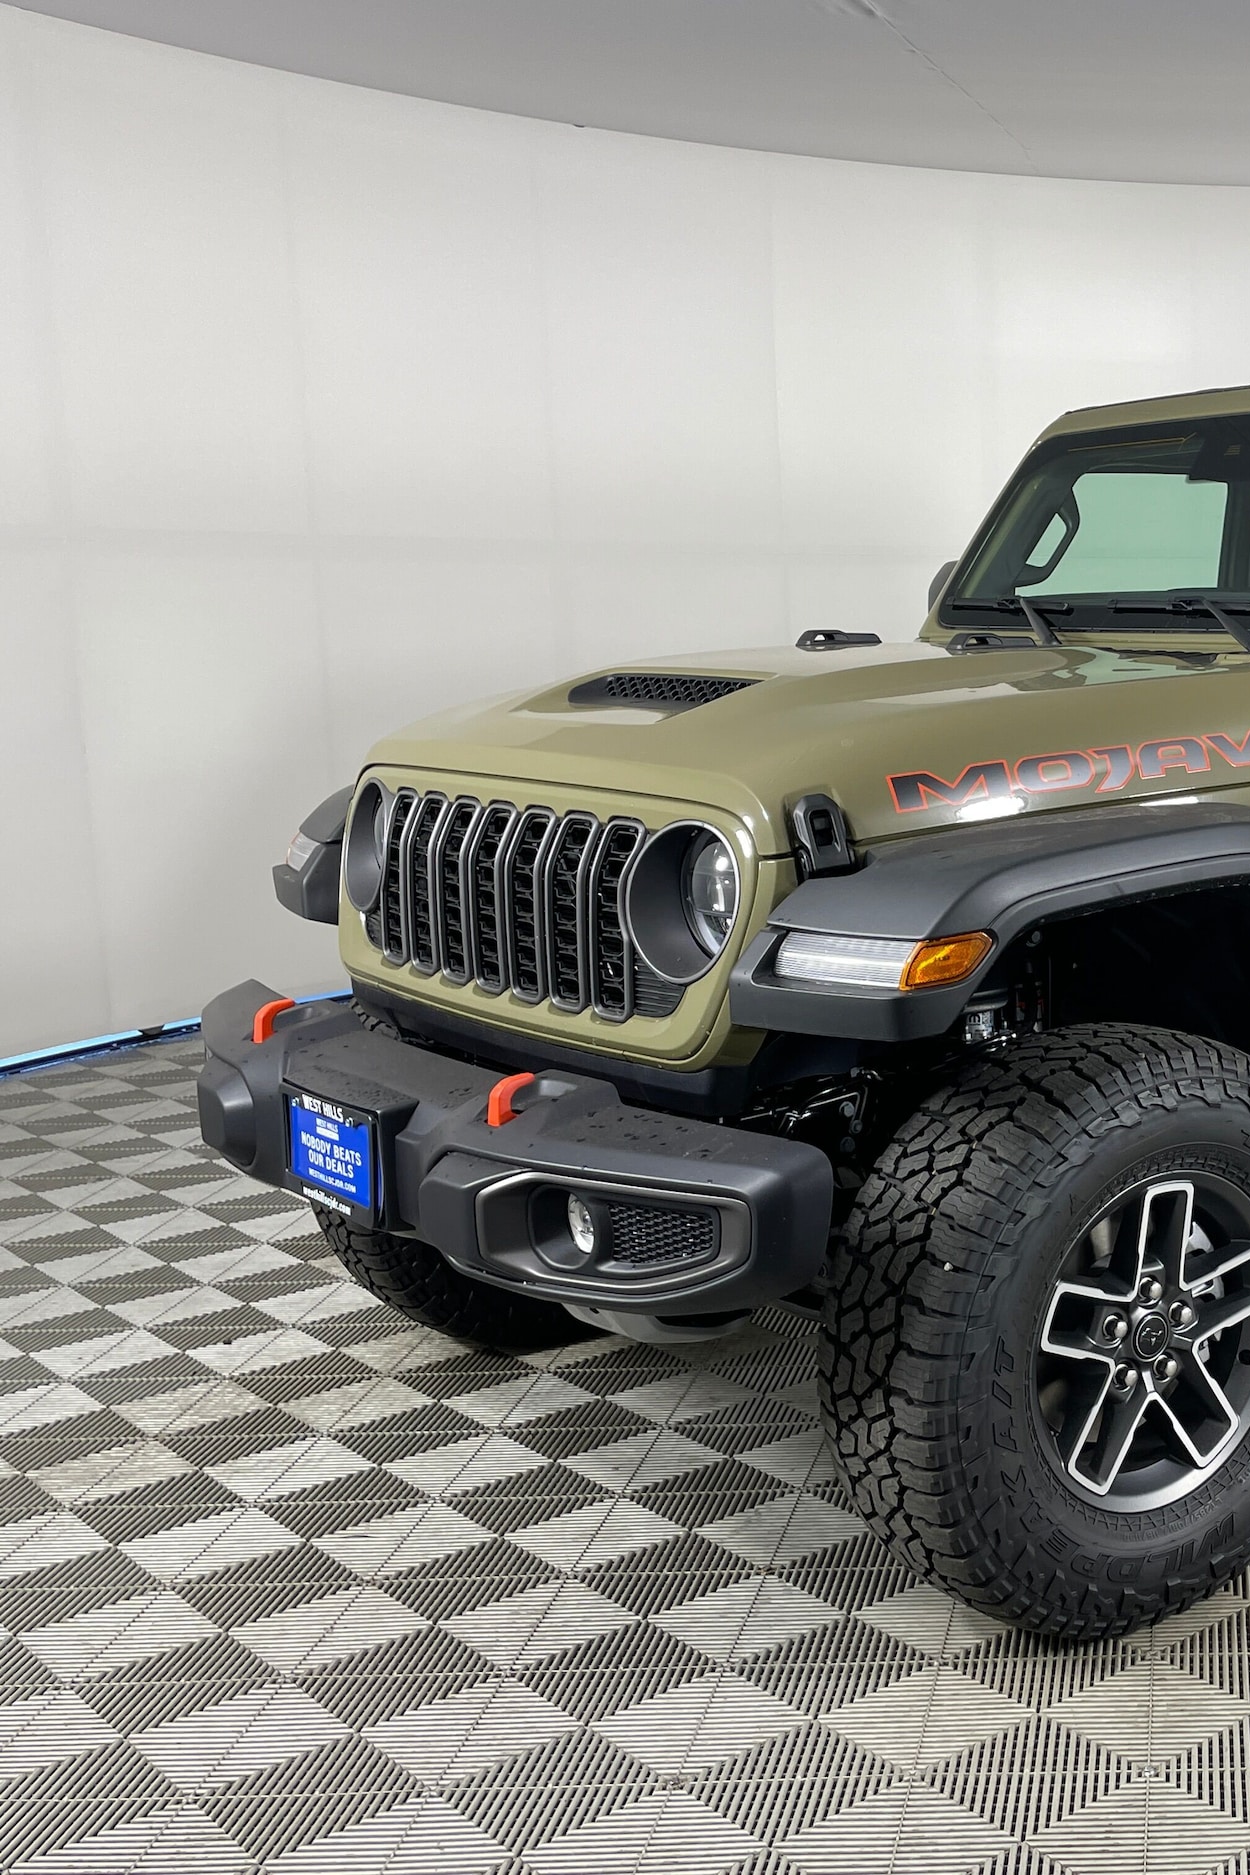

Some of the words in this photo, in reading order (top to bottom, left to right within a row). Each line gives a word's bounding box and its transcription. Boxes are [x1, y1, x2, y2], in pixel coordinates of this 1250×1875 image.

[302, 1093, 322, 1114] WEST
[321, 1101, 344, 1124] HILLS
[301, 1130, 331, 1155] NOBODY
[333, 1142, 362, 1167] BEATS
[308, 1149, 325, 1168] OUR
[325, 1156, 354, 1179] DEALS
